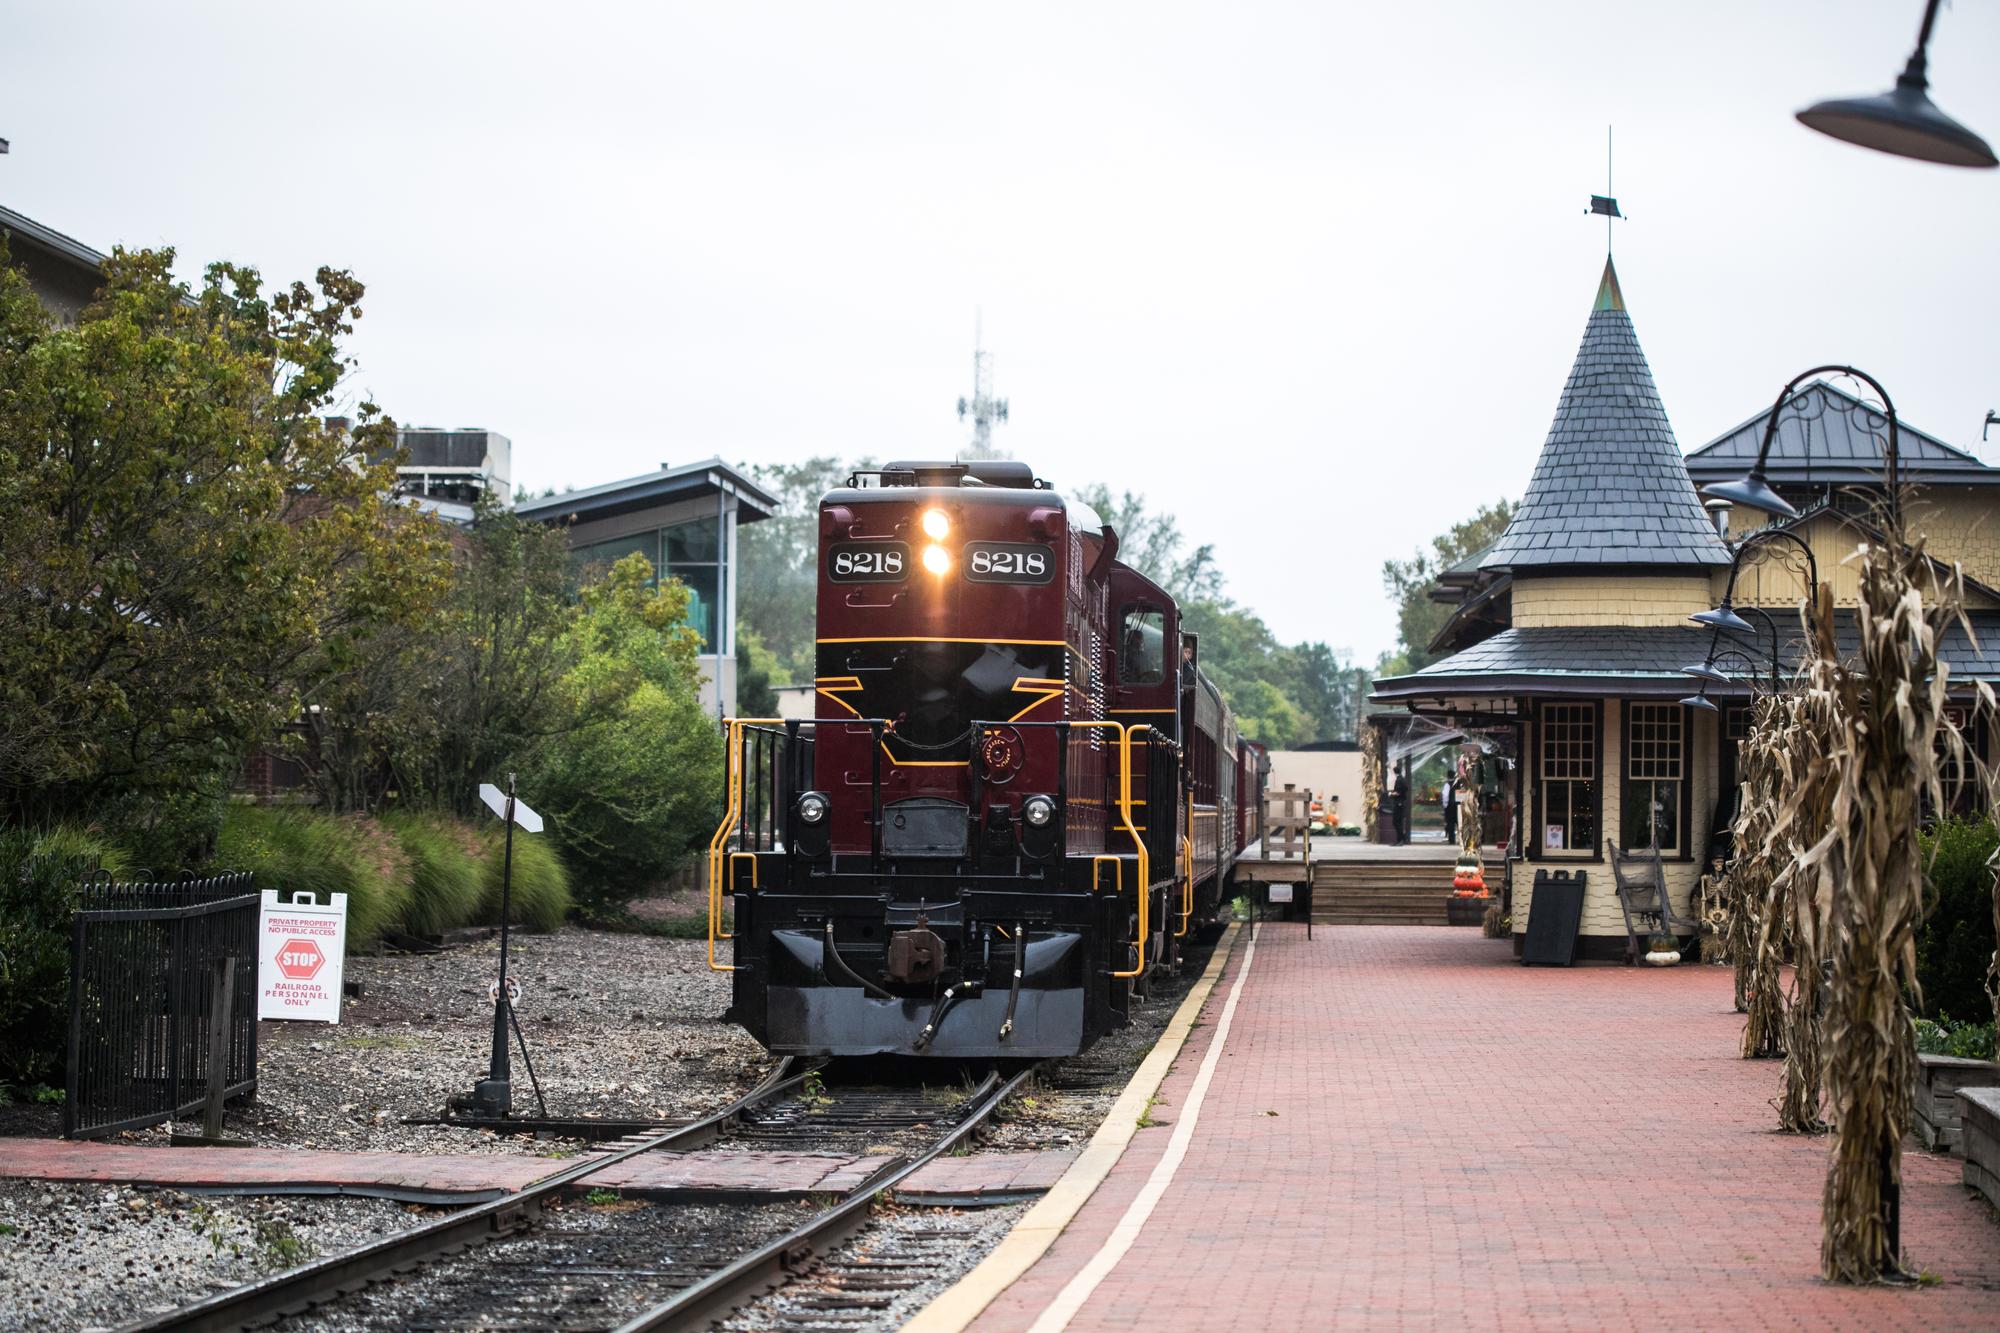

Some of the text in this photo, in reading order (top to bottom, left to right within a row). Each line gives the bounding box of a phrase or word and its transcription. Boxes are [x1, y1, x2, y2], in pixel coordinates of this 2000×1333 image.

[835, 551, 903, 575] 8218
[971, 551, 1045, 575] 8218
[268, 918, 337, 927] PRIVATE PROPERTY
[283, 952, 318, 966] STOP
[275, 983, 322, 991] RAILROAD
[265, 991, 329, 999] PERSONNEL
